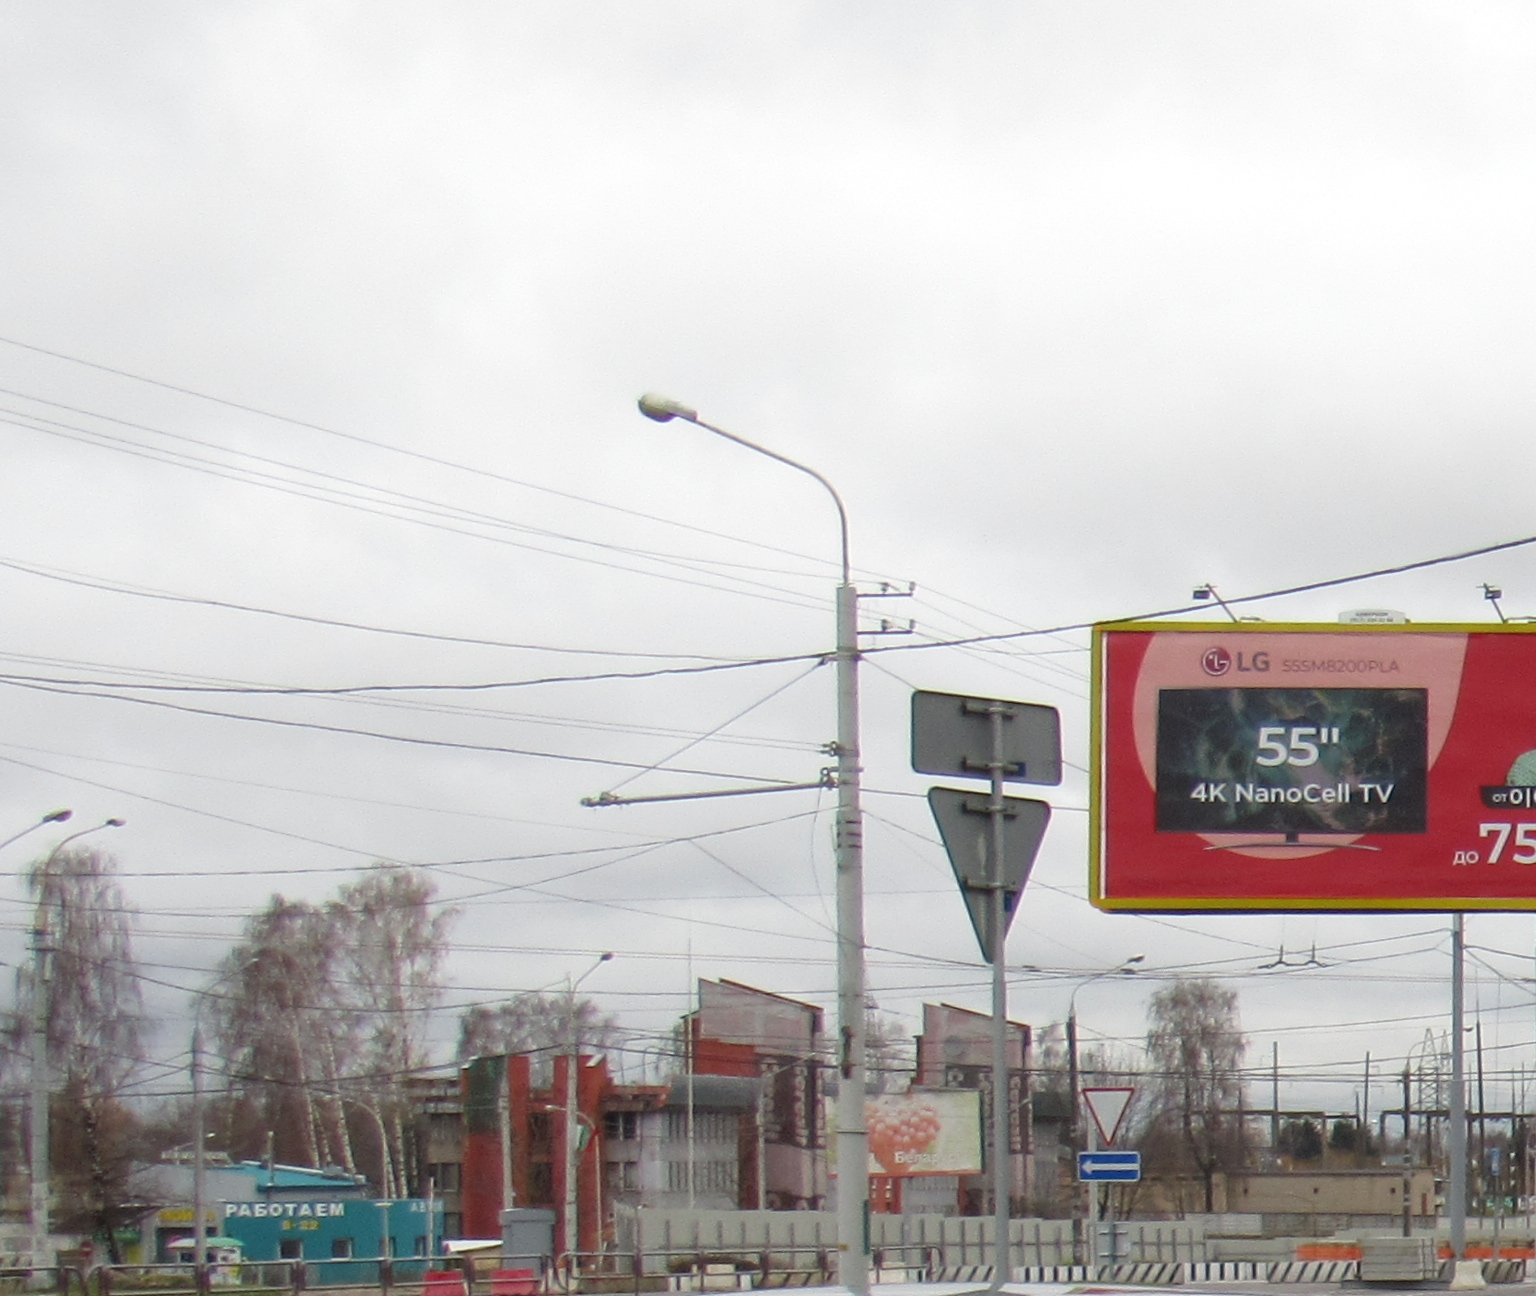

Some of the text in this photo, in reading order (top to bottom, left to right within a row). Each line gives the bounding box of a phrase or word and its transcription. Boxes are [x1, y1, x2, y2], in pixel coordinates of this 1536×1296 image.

[1237, 652, 1270, 672] LG
[1191, 783, 1395, 804] 4K NanoCell TV
[225, 1203, 345, 1217] РАБОТАЕМ
